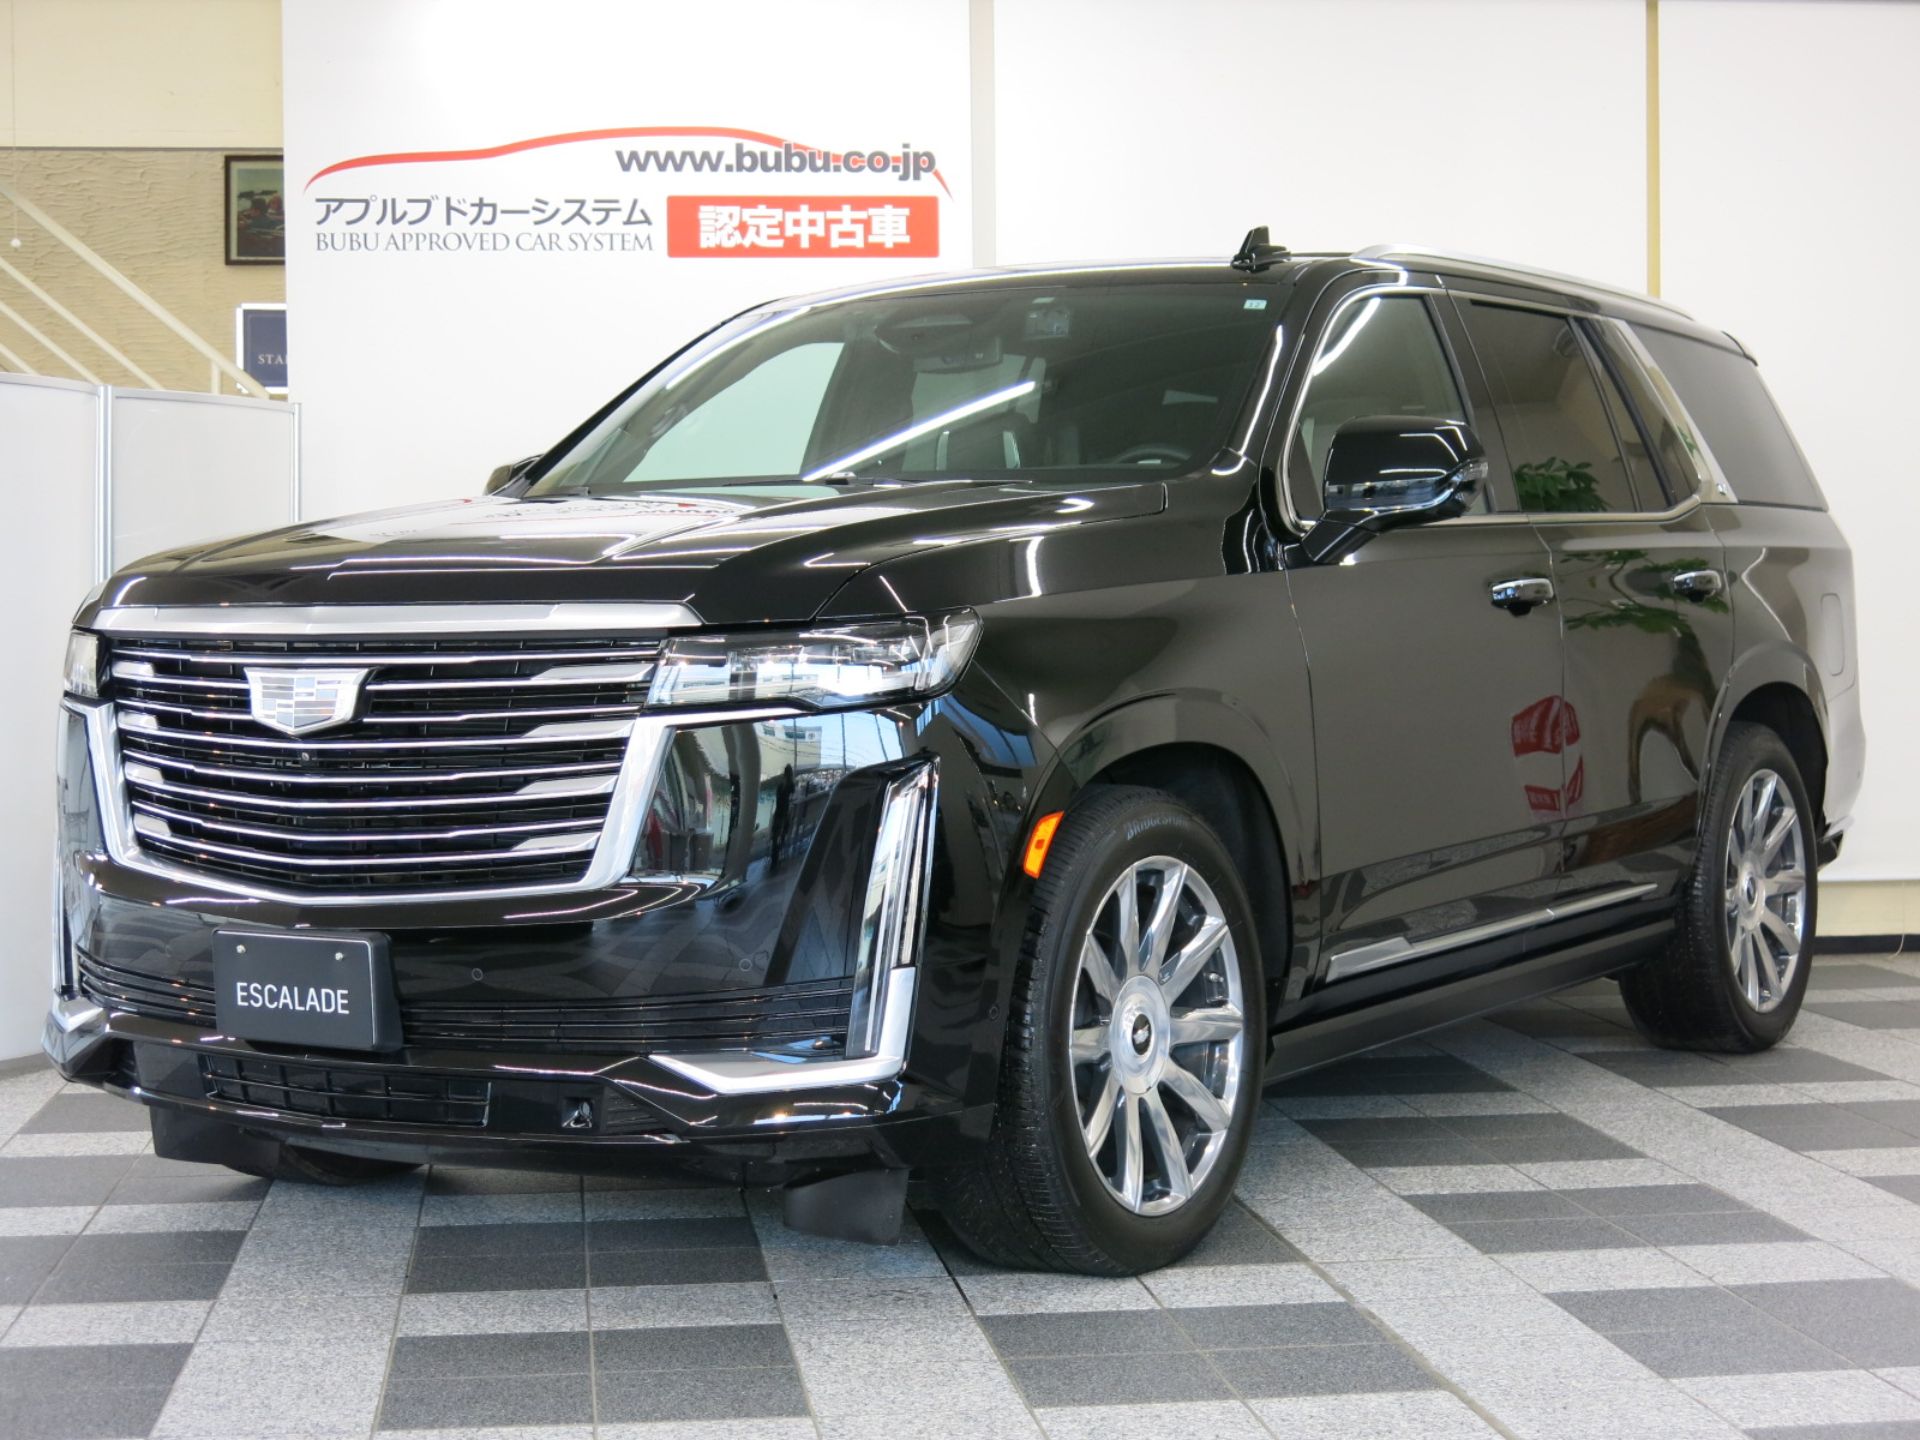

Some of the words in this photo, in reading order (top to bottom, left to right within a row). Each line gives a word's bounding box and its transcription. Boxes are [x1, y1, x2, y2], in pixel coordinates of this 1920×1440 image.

[615, 143, 936, 181] www.bubu.co.jp
[315, 194, 653, 226] アプルブドカーシステム
[316, 232, 379, 251] BUBU
[385, 232, 510, 251] APPROVED
[516, 232, 563, 251] CAR
[568, 232, 654, 251] SYSTEM
[698, 204, 911, 249] 認定中古車
[257, 353, 288, 365] STA
[236, 982, 350, 1014] ESCALADE
